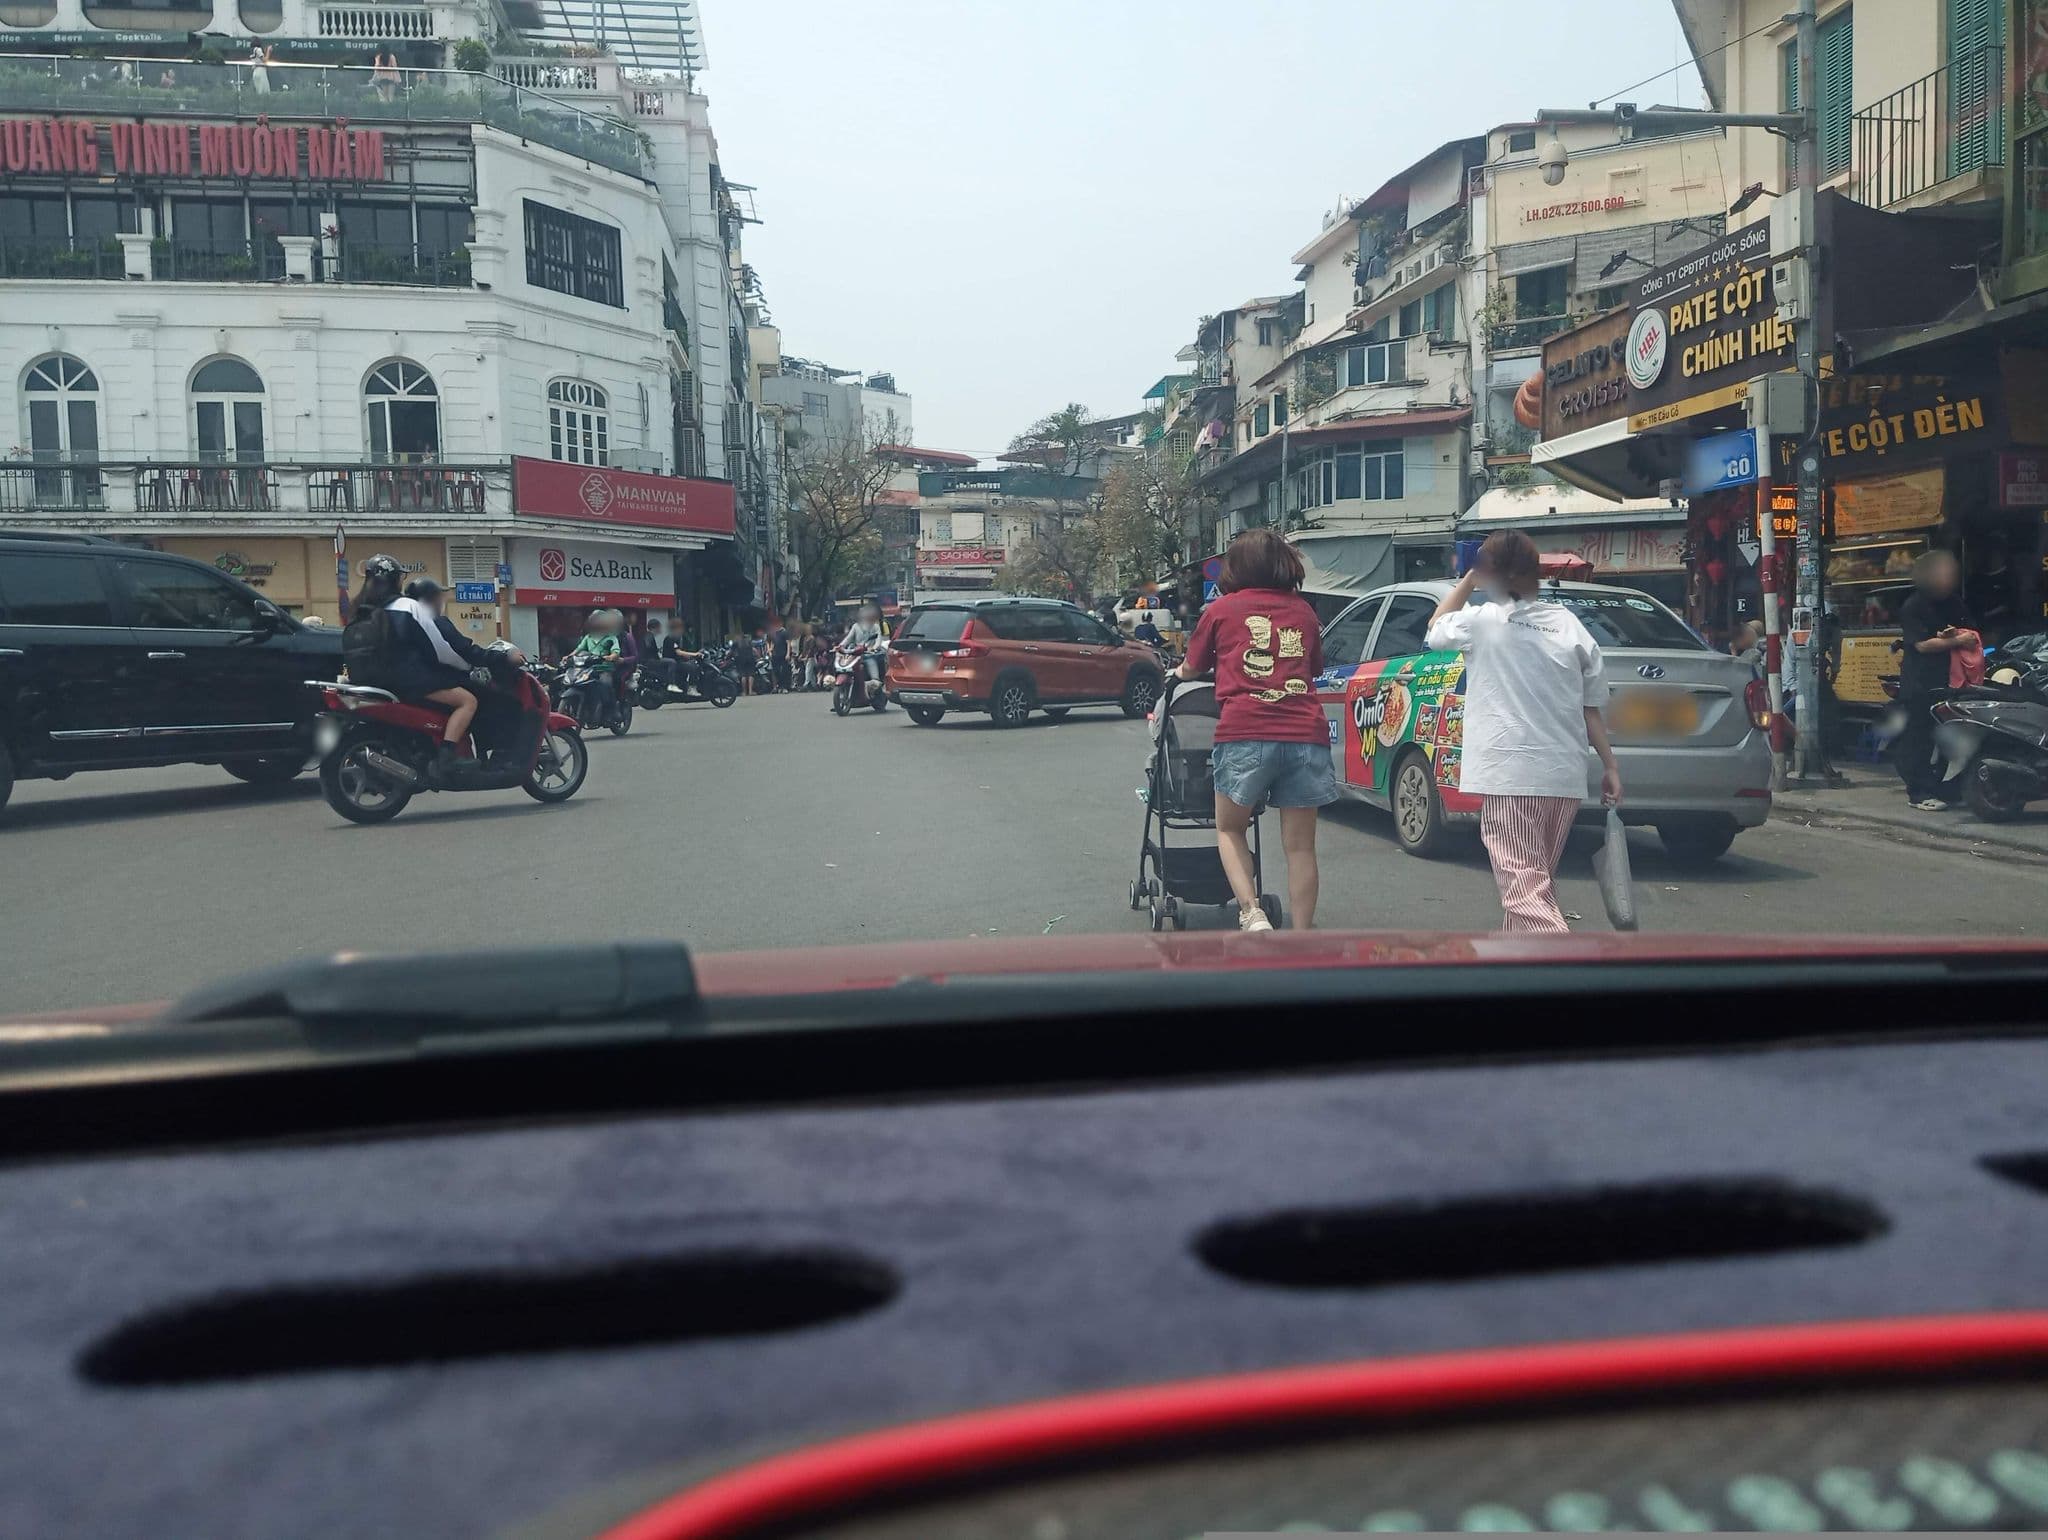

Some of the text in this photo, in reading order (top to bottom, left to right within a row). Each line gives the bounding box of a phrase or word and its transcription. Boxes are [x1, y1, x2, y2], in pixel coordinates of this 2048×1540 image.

[0, 33, 162, 42] ffee Beers Cocktails
[291, 41, 318, 49] Pasta
[345, 41, 379, 50] Burger
[0, 113, 385, 180] UANG VINH MUÔN NĂM
[1641, 229, 1766, 296] CÔNG TY CPĐTPT CUỘC SỐNG
[1670, 265, 1767, 336] PATE CỘT
[1638, 325, 1660, 360] HBL
[1682, 328, 1743, 378] CHÍNH
[1648, 413, 1657, 425] 116
[1849, 408, 1905, 455] CỘT
[1913, 395, 1985, 440] ĐÈN
[616, 485, 687, 506] MANWAH
[940, 551, 981, 560] SACHIKO
[570, 557, 653, 581] SeABank
[1328, 721, 1338, 737] XI
